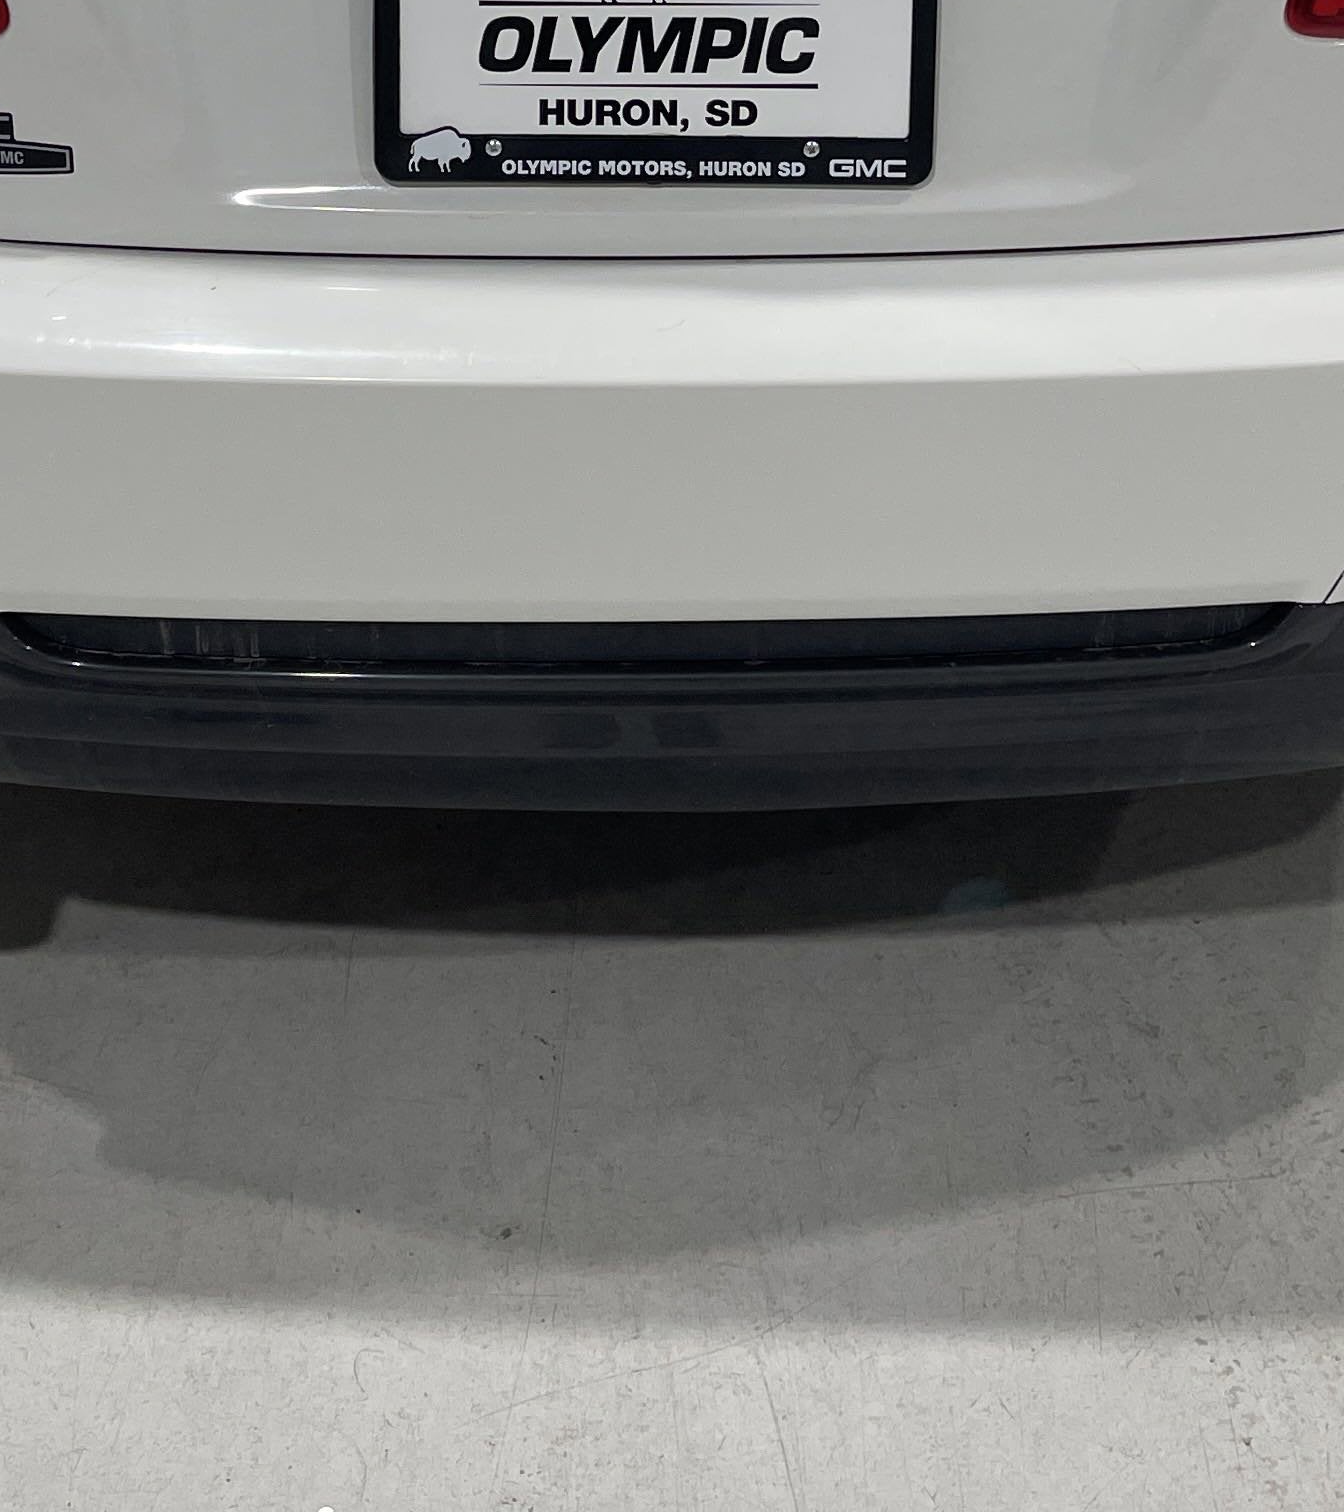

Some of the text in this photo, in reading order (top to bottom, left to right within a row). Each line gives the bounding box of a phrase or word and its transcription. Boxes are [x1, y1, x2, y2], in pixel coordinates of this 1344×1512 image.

[478, 15, 820, 74] OLYMPIC
[538, 98, 759, 132] HURON, SD
[501, 159, 806, 179] OLYMPIC MOTORS, HURON SD
[828, 158, 907, 178] GMC
